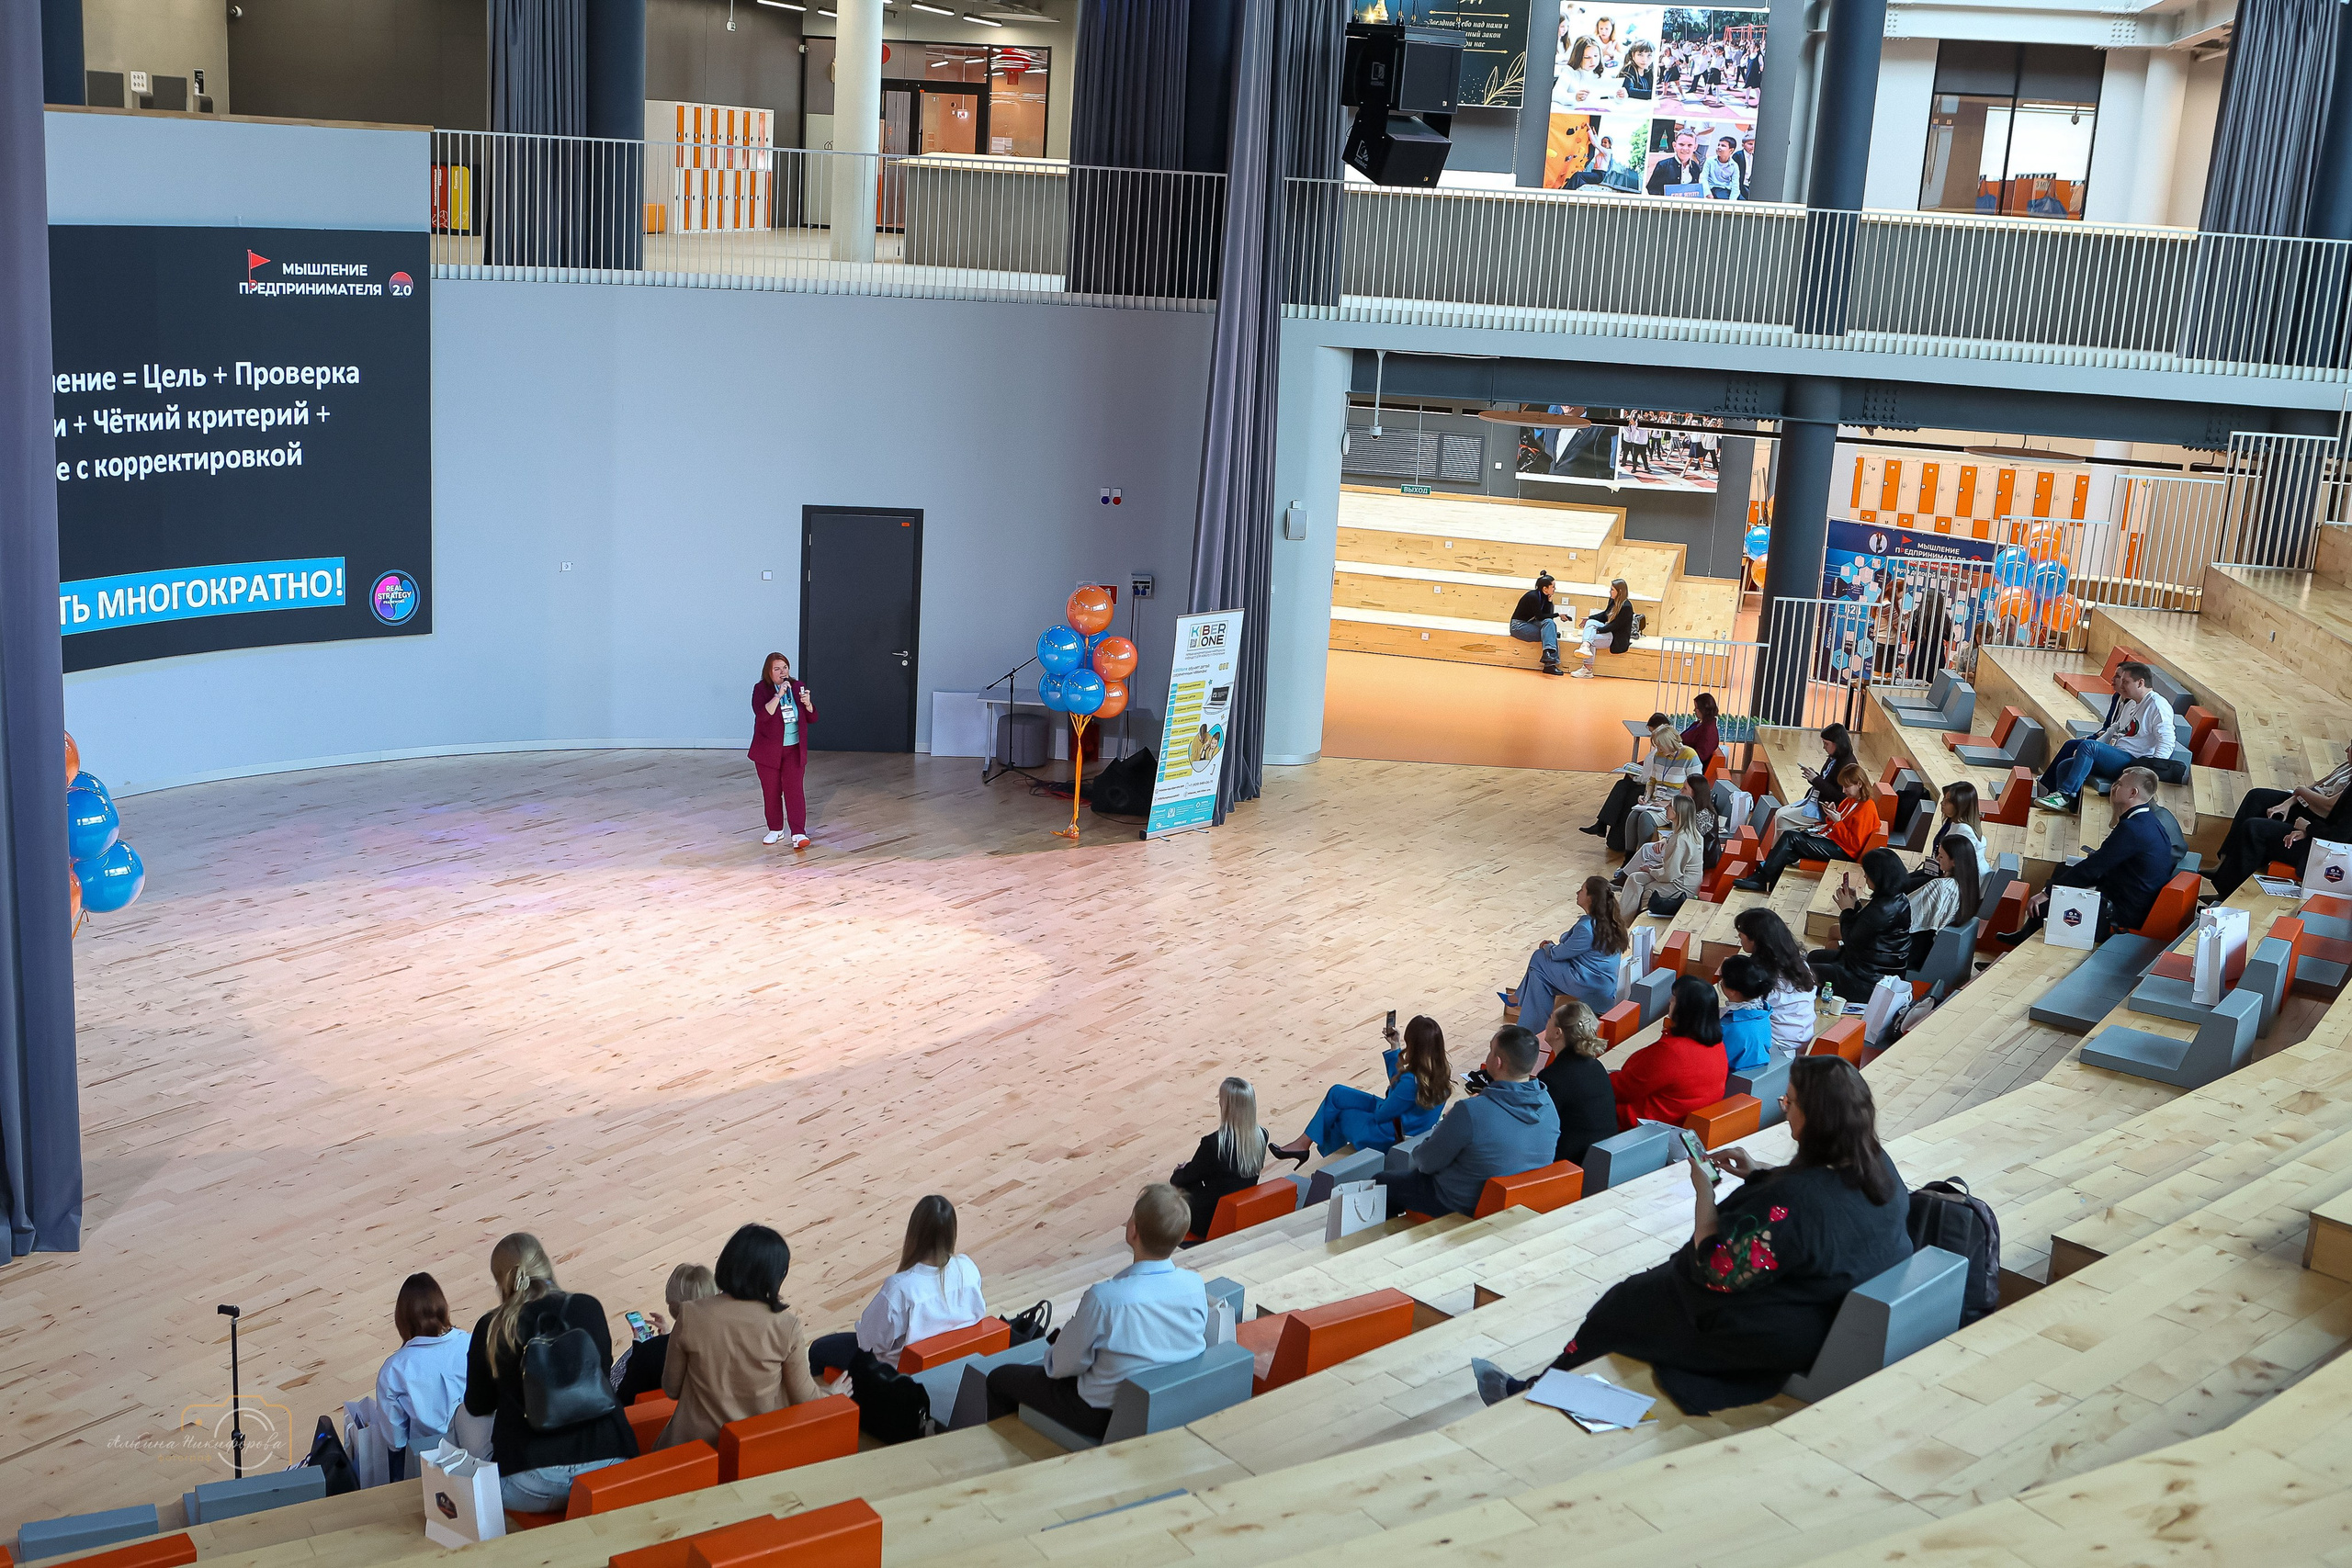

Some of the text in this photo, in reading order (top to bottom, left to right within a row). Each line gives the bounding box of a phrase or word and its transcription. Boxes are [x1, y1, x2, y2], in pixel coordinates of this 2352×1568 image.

[1487, 21, 1503, 29] нами
[282, 263, 368, 276] МЫШЛЕНИЕ
[239, 280, 413, 297] ПРЕДПРИНИМАТЕЛЯ 2.0
[143, 364, 206, 394] Цель
[235, 361, 360, 390] Проверка
[93, 404, 180, 434] Чёткий
[187, 400, 309, 434] критерий
[95, 441, 303, 481] корректировкой
[1403, 486, 1429, 494] ВЫХОД
[1917, 542, 1961, 555] МЫШЛЕНИЕ
[97, 567, 344, 620] МНОГОКРАТНО!
[378, 592, 412, 600] STRATEGY
[1191, 624, 1227, 638] KIBER
[1201, 635, 1224, 647] ONE
